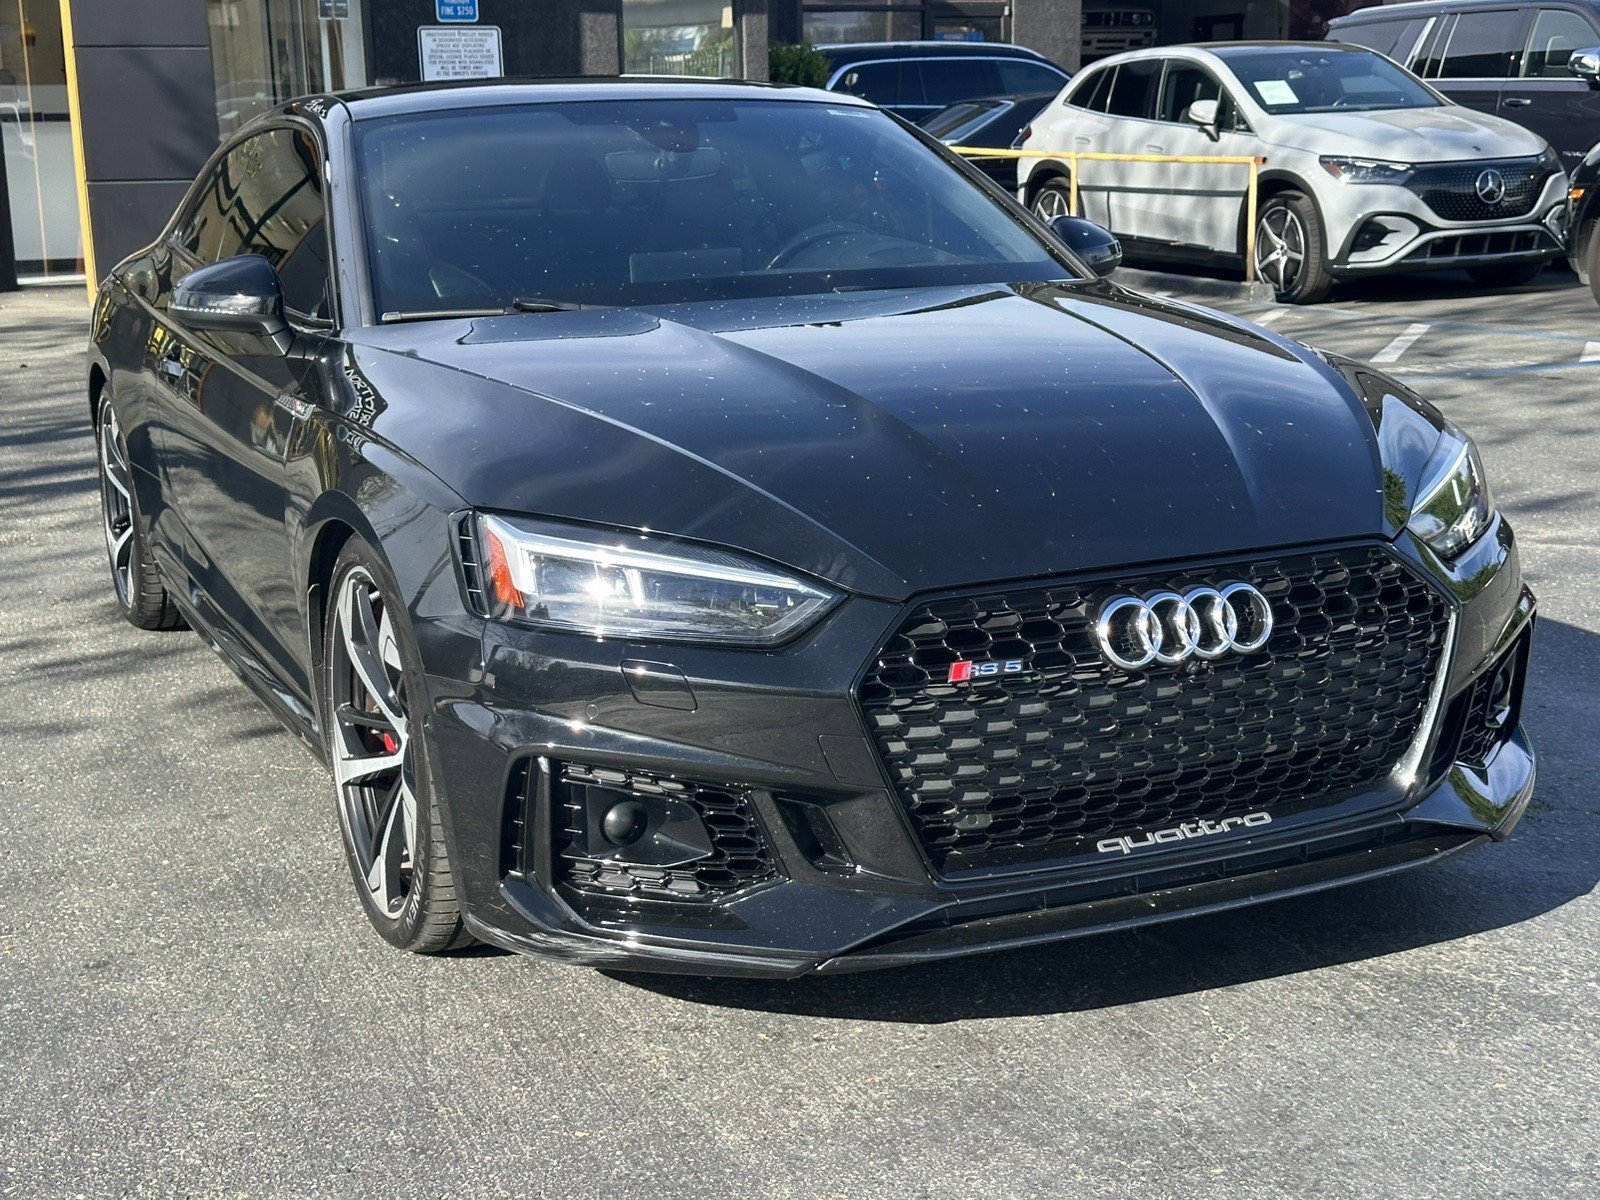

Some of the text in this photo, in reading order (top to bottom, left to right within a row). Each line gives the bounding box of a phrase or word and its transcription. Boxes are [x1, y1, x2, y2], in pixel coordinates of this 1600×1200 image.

[441, 6, 474, 16] FINE $250
[962, 660, 1022, 678] RS 5
[1097, 811, 1272, 854] quattro
